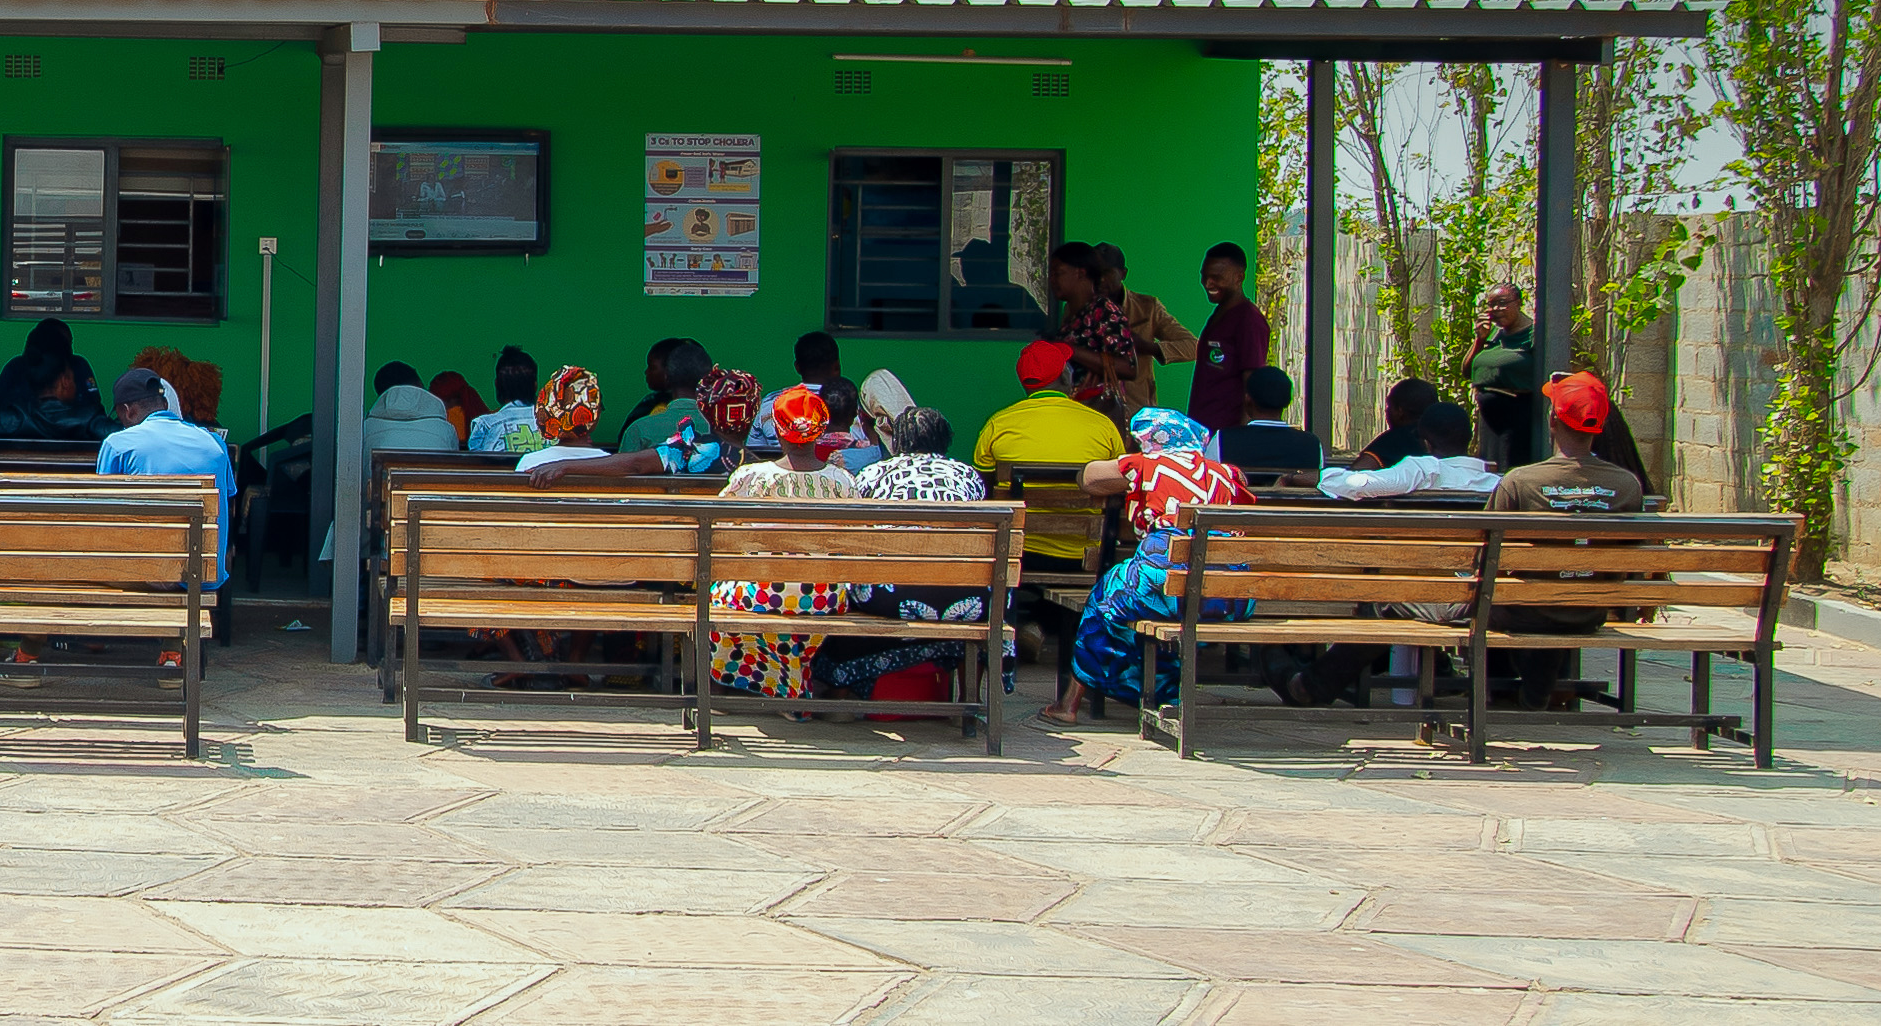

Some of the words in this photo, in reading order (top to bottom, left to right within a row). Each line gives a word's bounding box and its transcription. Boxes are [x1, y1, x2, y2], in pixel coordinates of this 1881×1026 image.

[650, 137, 656, 145] 3
[671, 137, 685, 145] TO
[686, 138, 711, 146] STOP
[712, 138, 754, 146] CHOLERA
